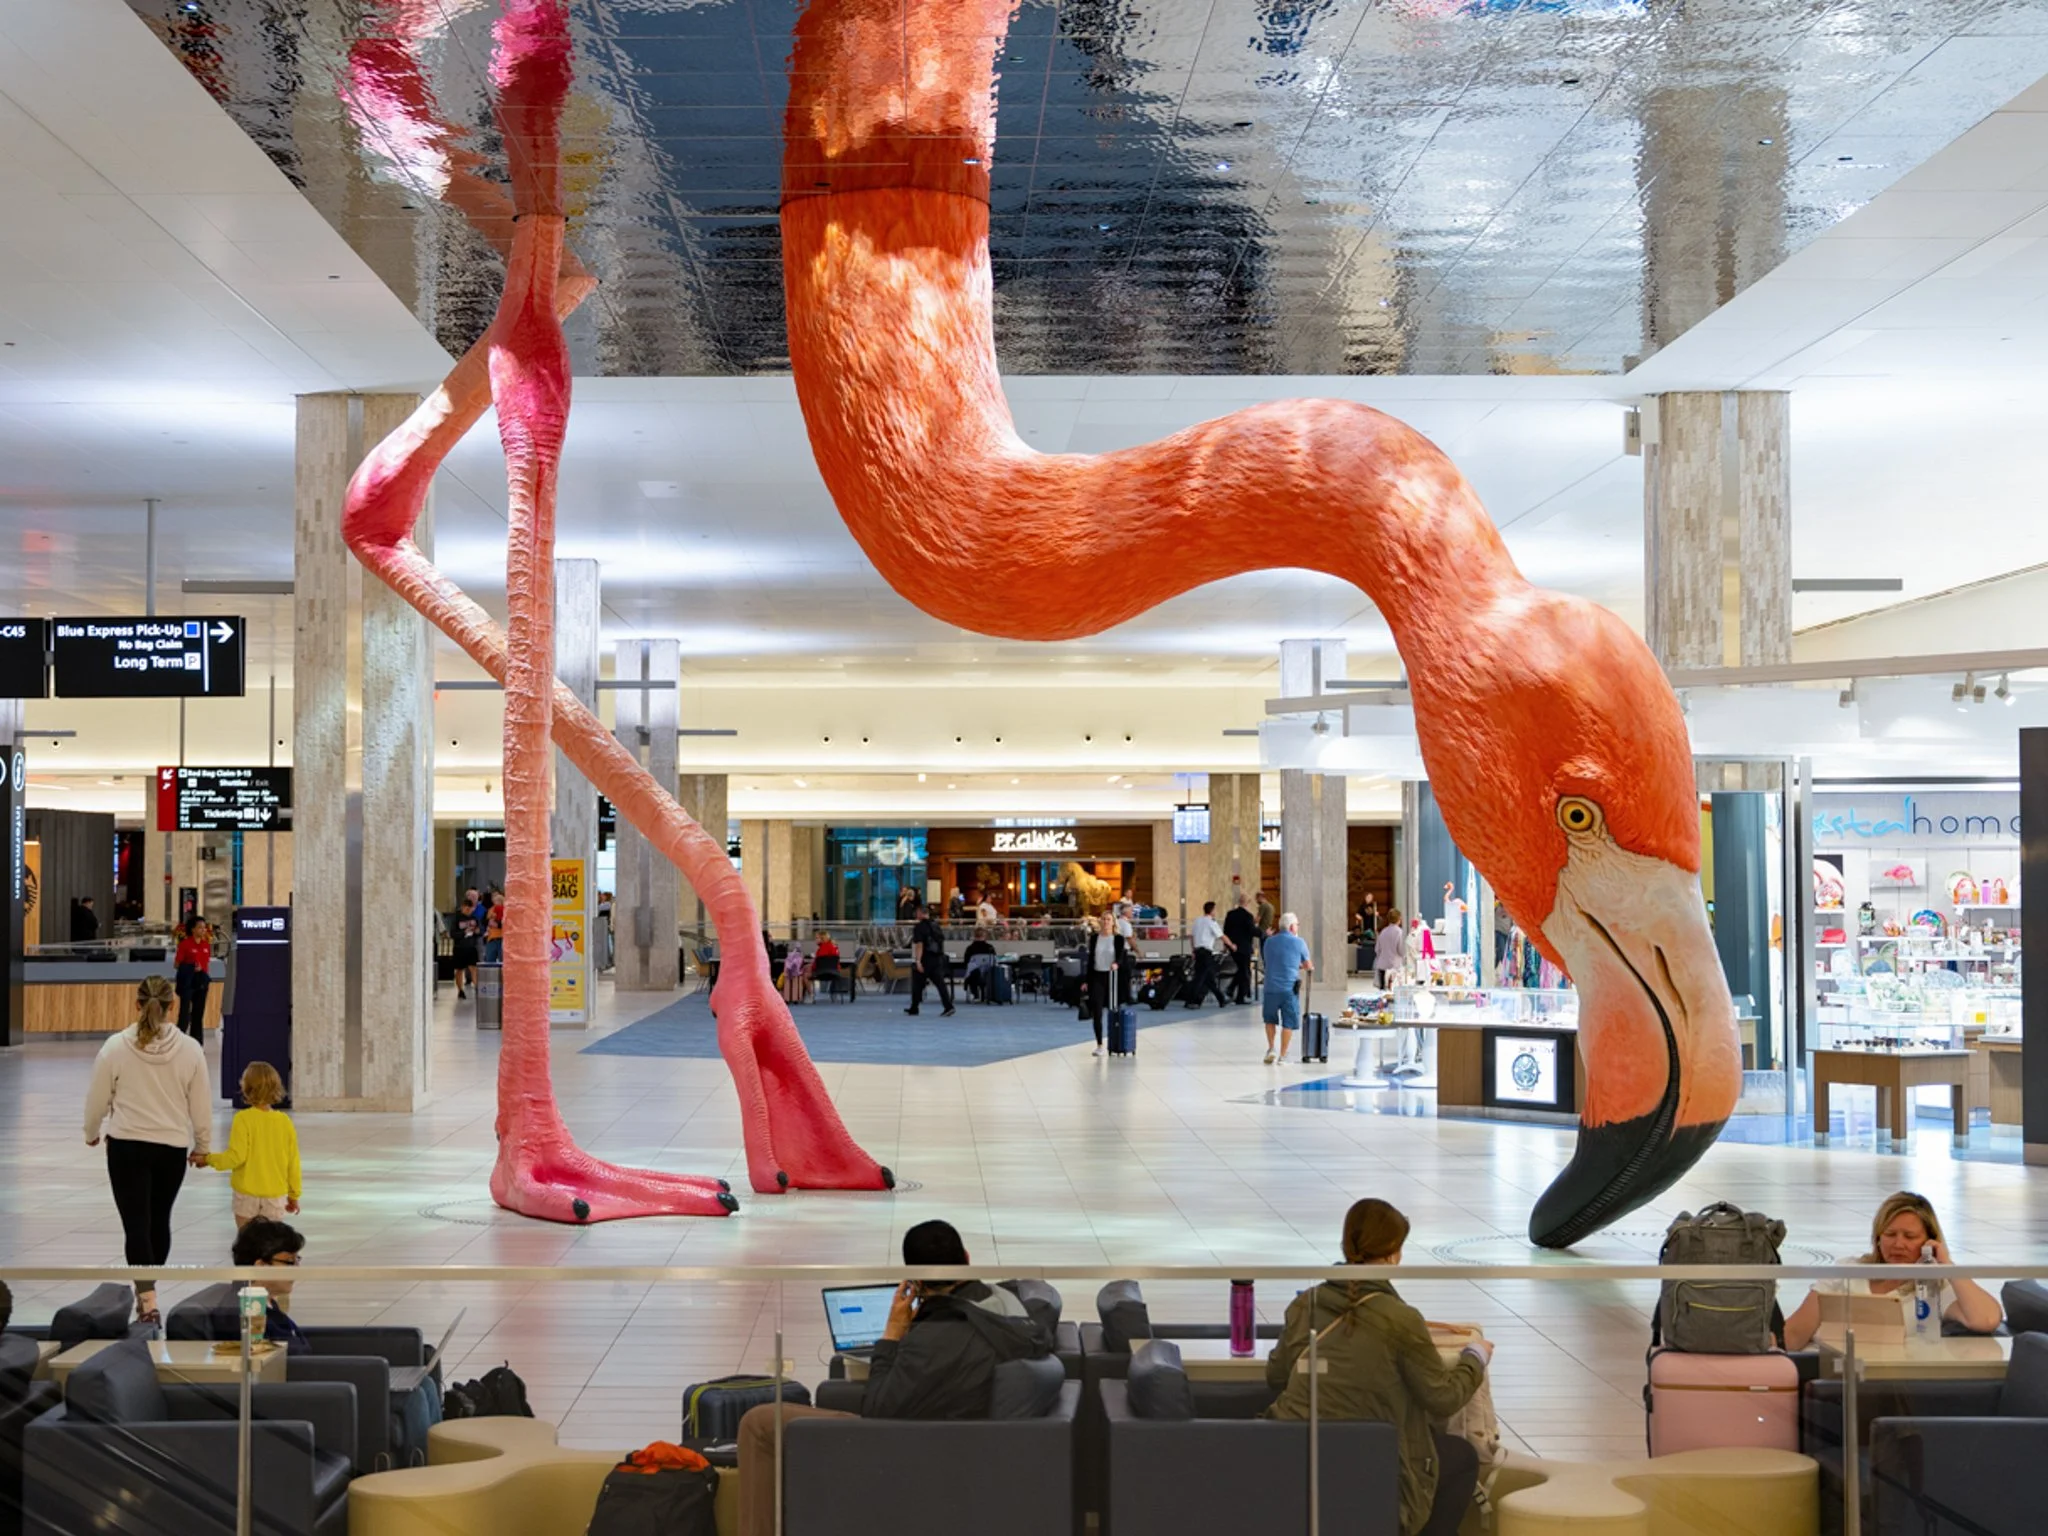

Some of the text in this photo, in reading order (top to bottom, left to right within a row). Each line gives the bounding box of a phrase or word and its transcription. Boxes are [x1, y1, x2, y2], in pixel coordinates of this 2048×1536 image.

[57, 624, 182, 639] Blue Express Pick-Up
[118, 639, 183, 652] No Bag Claim
[114, 655, 147, 671] Long
[150, 655, 183, 668] Term
[203, 808, 243, 820] Ticketing
[241, 919, 272, 929] TRUIST
